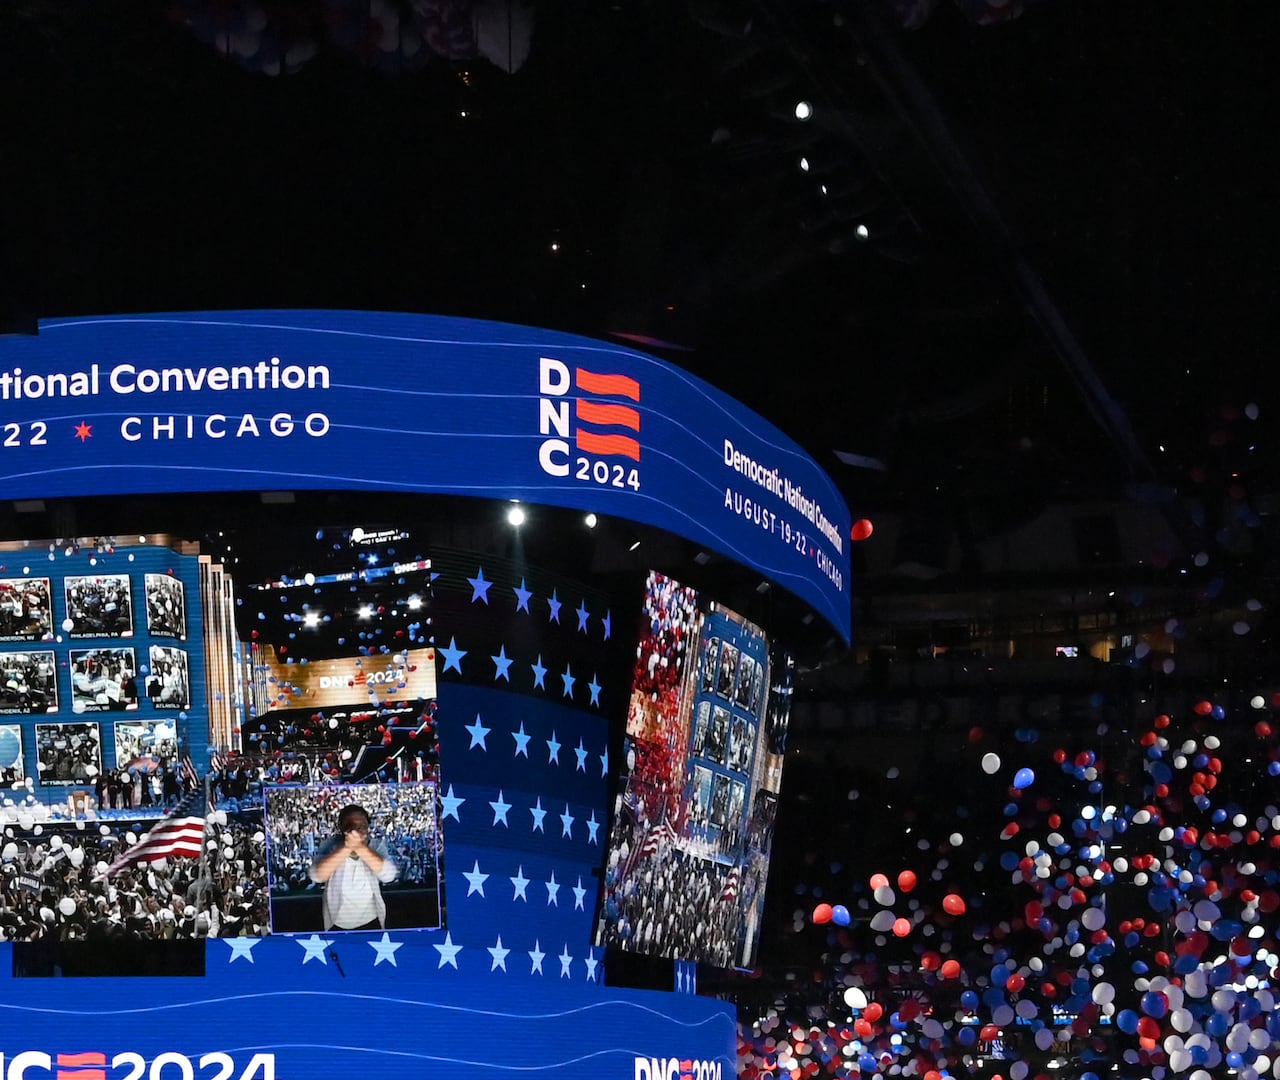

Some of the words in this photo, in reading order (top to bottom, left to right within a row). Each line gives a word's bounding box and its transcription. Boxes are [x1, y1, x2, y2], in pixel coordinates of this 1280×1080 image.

[109, 357, 331, 394] Convention
[120, 412, 331, 442] CHICAGO
[539, 358, 571, 477] DNC
[576, 459, 640, 490] 2024
[724, 439, 782, 498] Democratic
[785, 478, 815, 526] National
[815, 505, 842, 555] Convention
[725, 488, 775, 533] AUGUST
[780, 520, 806, 555] 19-22
[817, 549, 842, 592] CHICAGO
